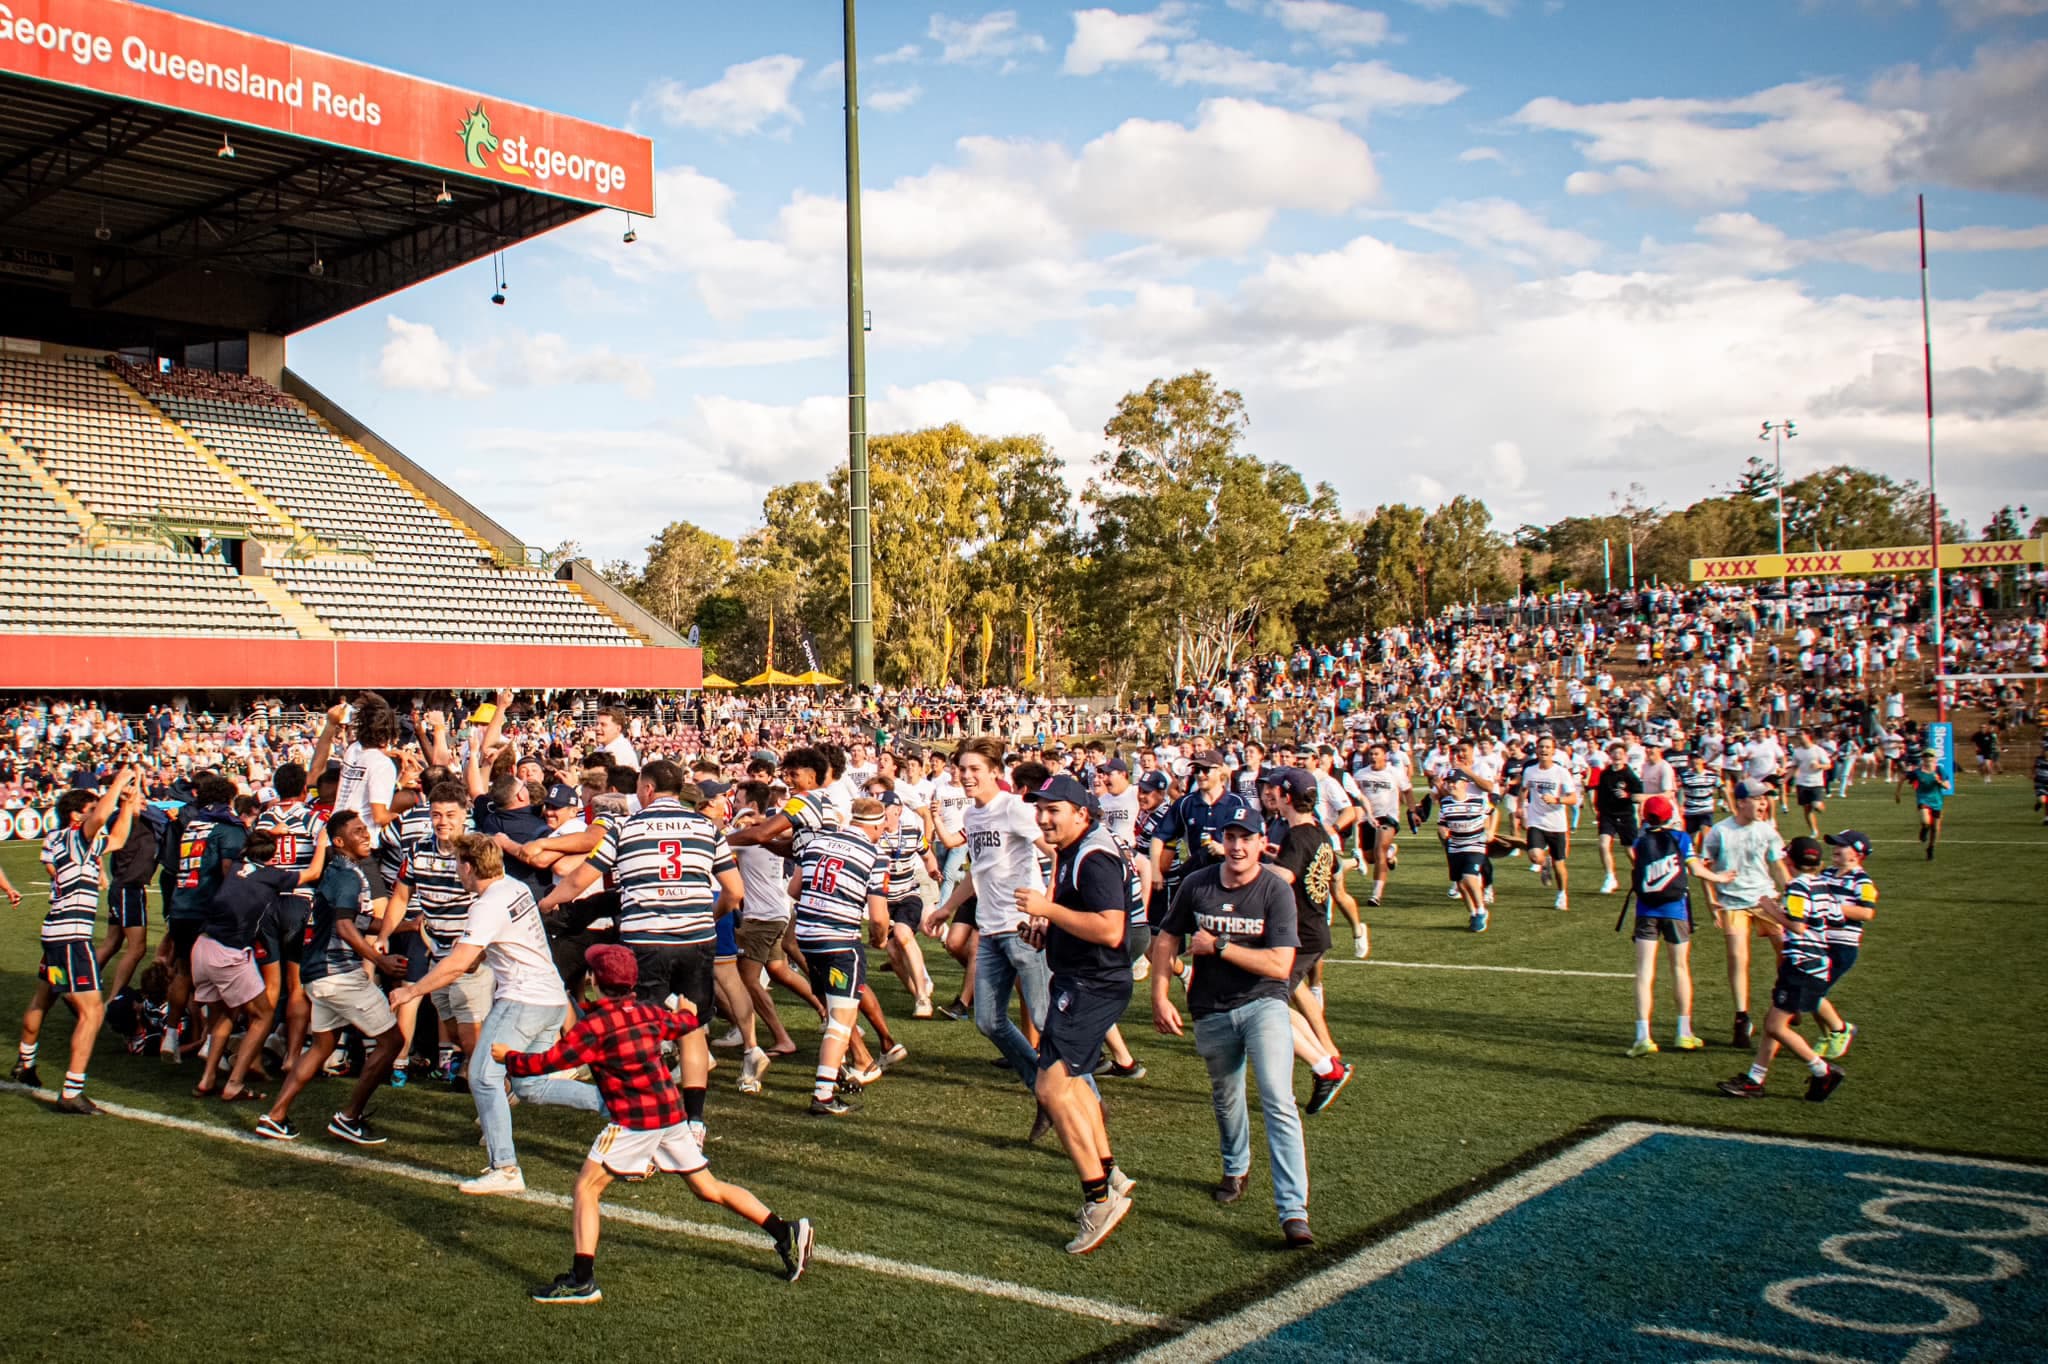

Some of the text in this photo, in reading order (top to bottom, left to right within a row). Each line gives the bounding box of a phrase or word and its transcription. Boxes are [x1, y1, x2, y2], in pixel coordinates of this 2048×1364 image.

[121, 35, 303, 109] Queensland
[312, 81, 382, 126] Reds
[502, 135, 627, 194] st.george
[1872, 550, 1930, 568] XXXX
[1961, 544, 2024, 563] XXXX
[1704, 559, 1758, 577] XXXX
[1786, 555, 1842, 573] XXXX
[1235, 808, 1247, 820] B
[646, 822, 692, 831] XENIA
[659, 840, 683, 880] 3
[1646, 853, 1680, 882] NIKE
[810, 855, 845, 894] 16
[666, 888, 688, 897] ACU
